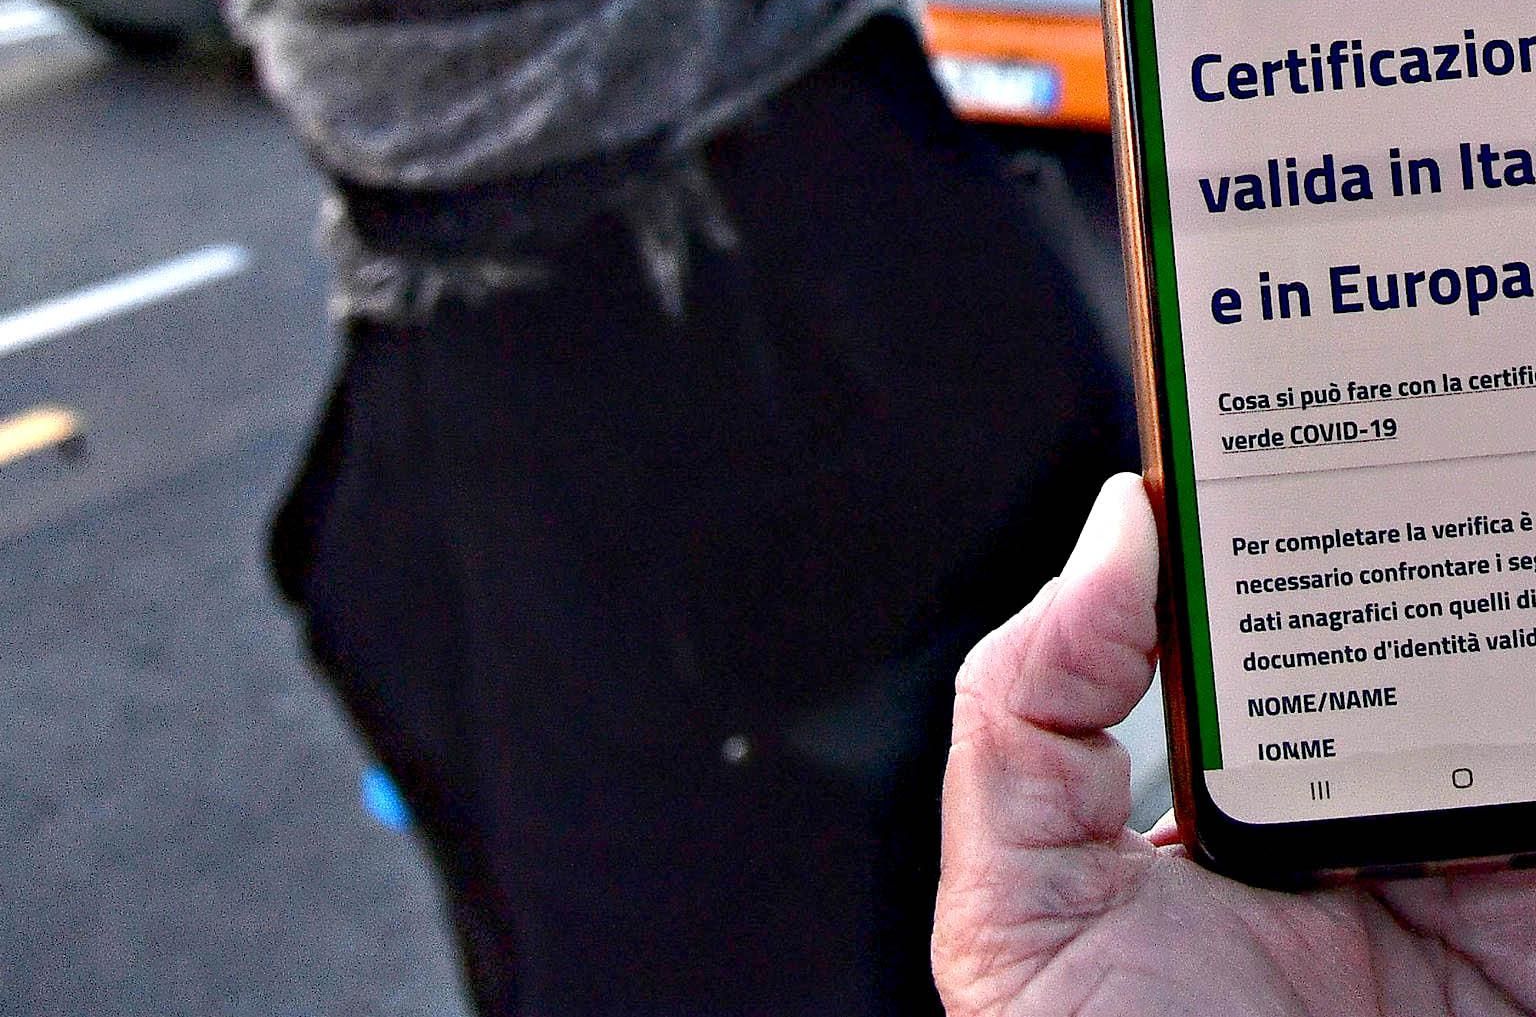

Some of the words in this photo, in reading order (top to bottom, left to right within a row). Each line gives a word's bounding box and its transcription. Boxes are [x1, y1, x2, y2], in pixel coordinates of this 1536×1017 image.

[1198, 153, 1374, 213] valida
[1389, 147, 1442, 197] in
[1210, 287, 1242, 325] e
[1259, 271, 1311, 321] in
[1329, 261, 1535, 317] Europa
[1218, 392, 1271, 412] Cosa
[1277, 388, 1295, 407] si
[1301, 383, 1341, 410] può
[1346, 381, 1392, 401] fare
[1398, 379, 1437, 399] con
[1442, 373, 1463, 393] la
[1222, 427, 1284, 450] verde
[1291, 417, 1397, 445] COVID-19
[1232, 537, 1270, 557] Per
[1275, 528, 1401, 555] completare
[1406, 522, 1427, 542] la
[1431, 515, 1515, 540] verifica
[1519, 511, 1533, 532] è
[1235, 567, 1354, 595] necessario
[1359, 559, 1490, 585] confrontare
[1495, 553, 1502, 573] i
[1239, 611, 1282, 634] dati
[1288, 600, 1398, 632] anagrafici
[1404, 602, 1443, 620] con
[1449, 591, 1511, 621] quelli
[1516, 588, 1536, 610] di
[1243, 645, 1368, 672] documento
[1373, 632, 1481, 661] d'identità
[1247, 686, 1398, 718] NOME/NAME
